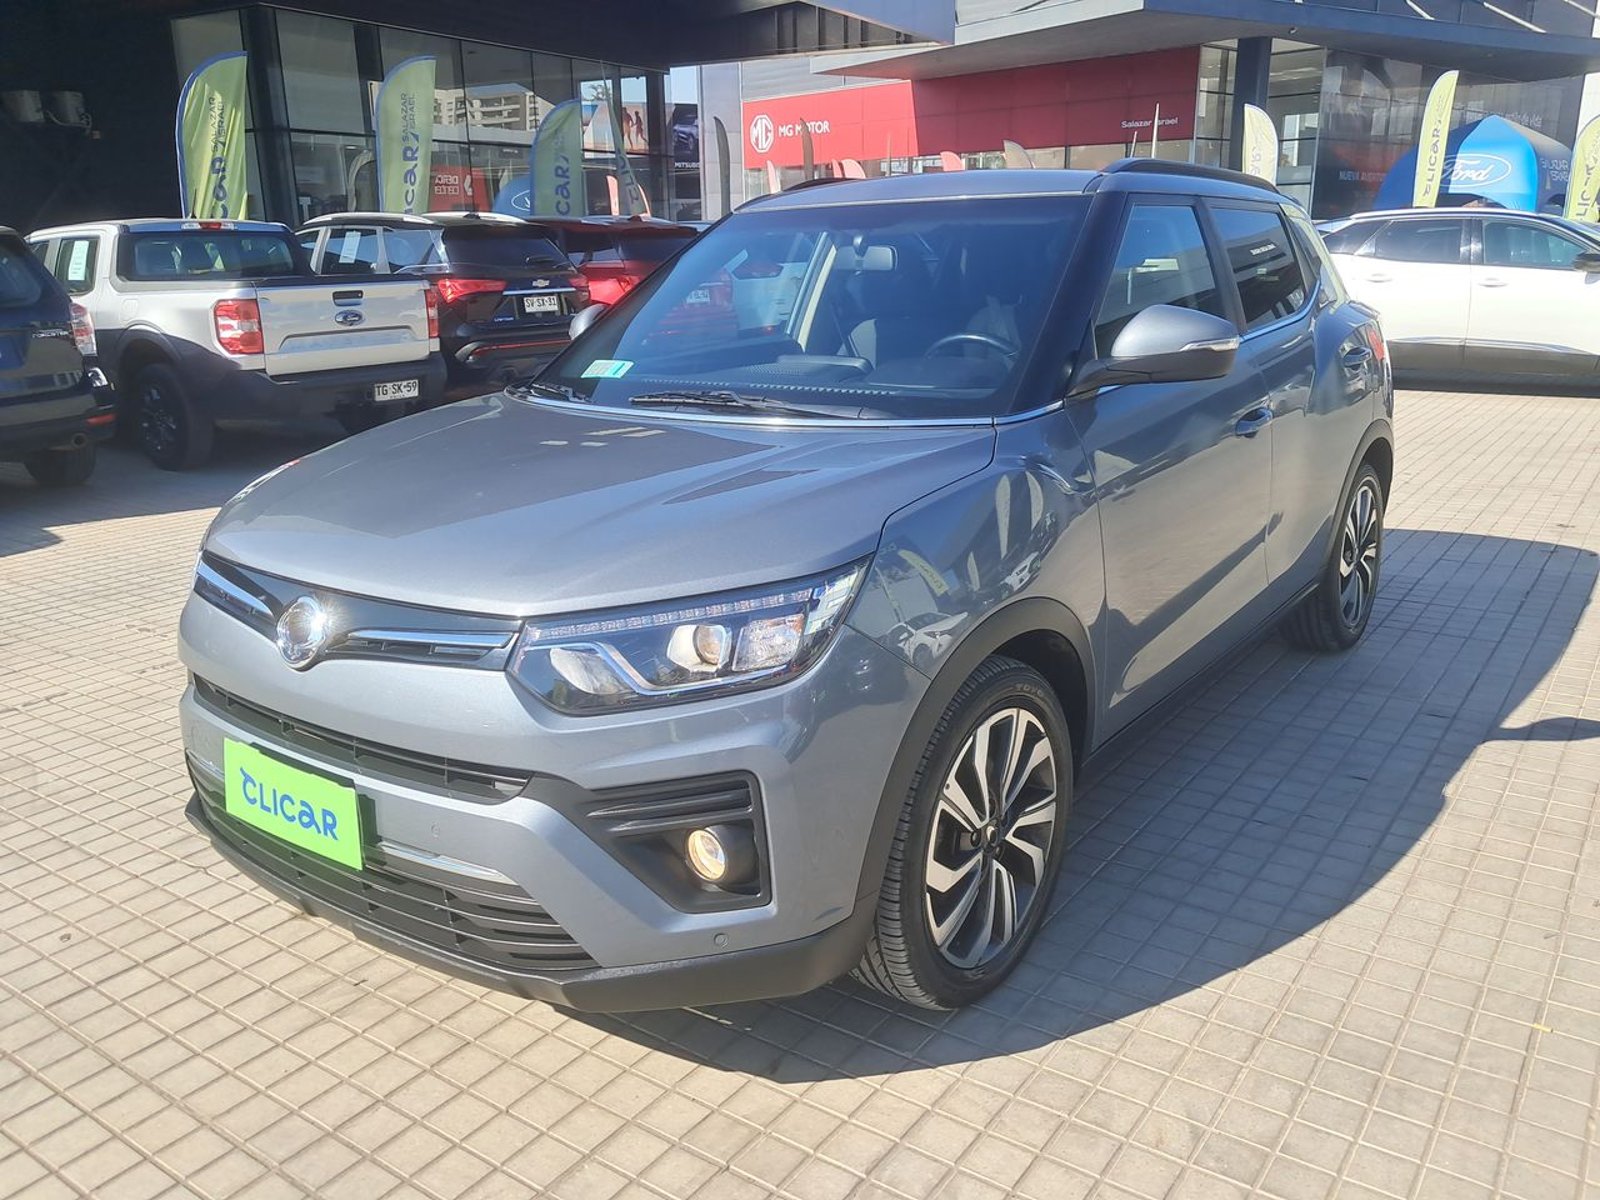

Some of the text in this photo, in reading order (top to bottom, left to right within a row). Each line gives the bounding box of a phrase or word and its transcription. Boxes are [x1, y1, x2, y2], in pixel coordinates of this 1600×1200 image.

[778, 124, 795, 137] MG
[1121, 120, 1152, 129] Salazar
[1441, 159, 1495, 181] Ford
